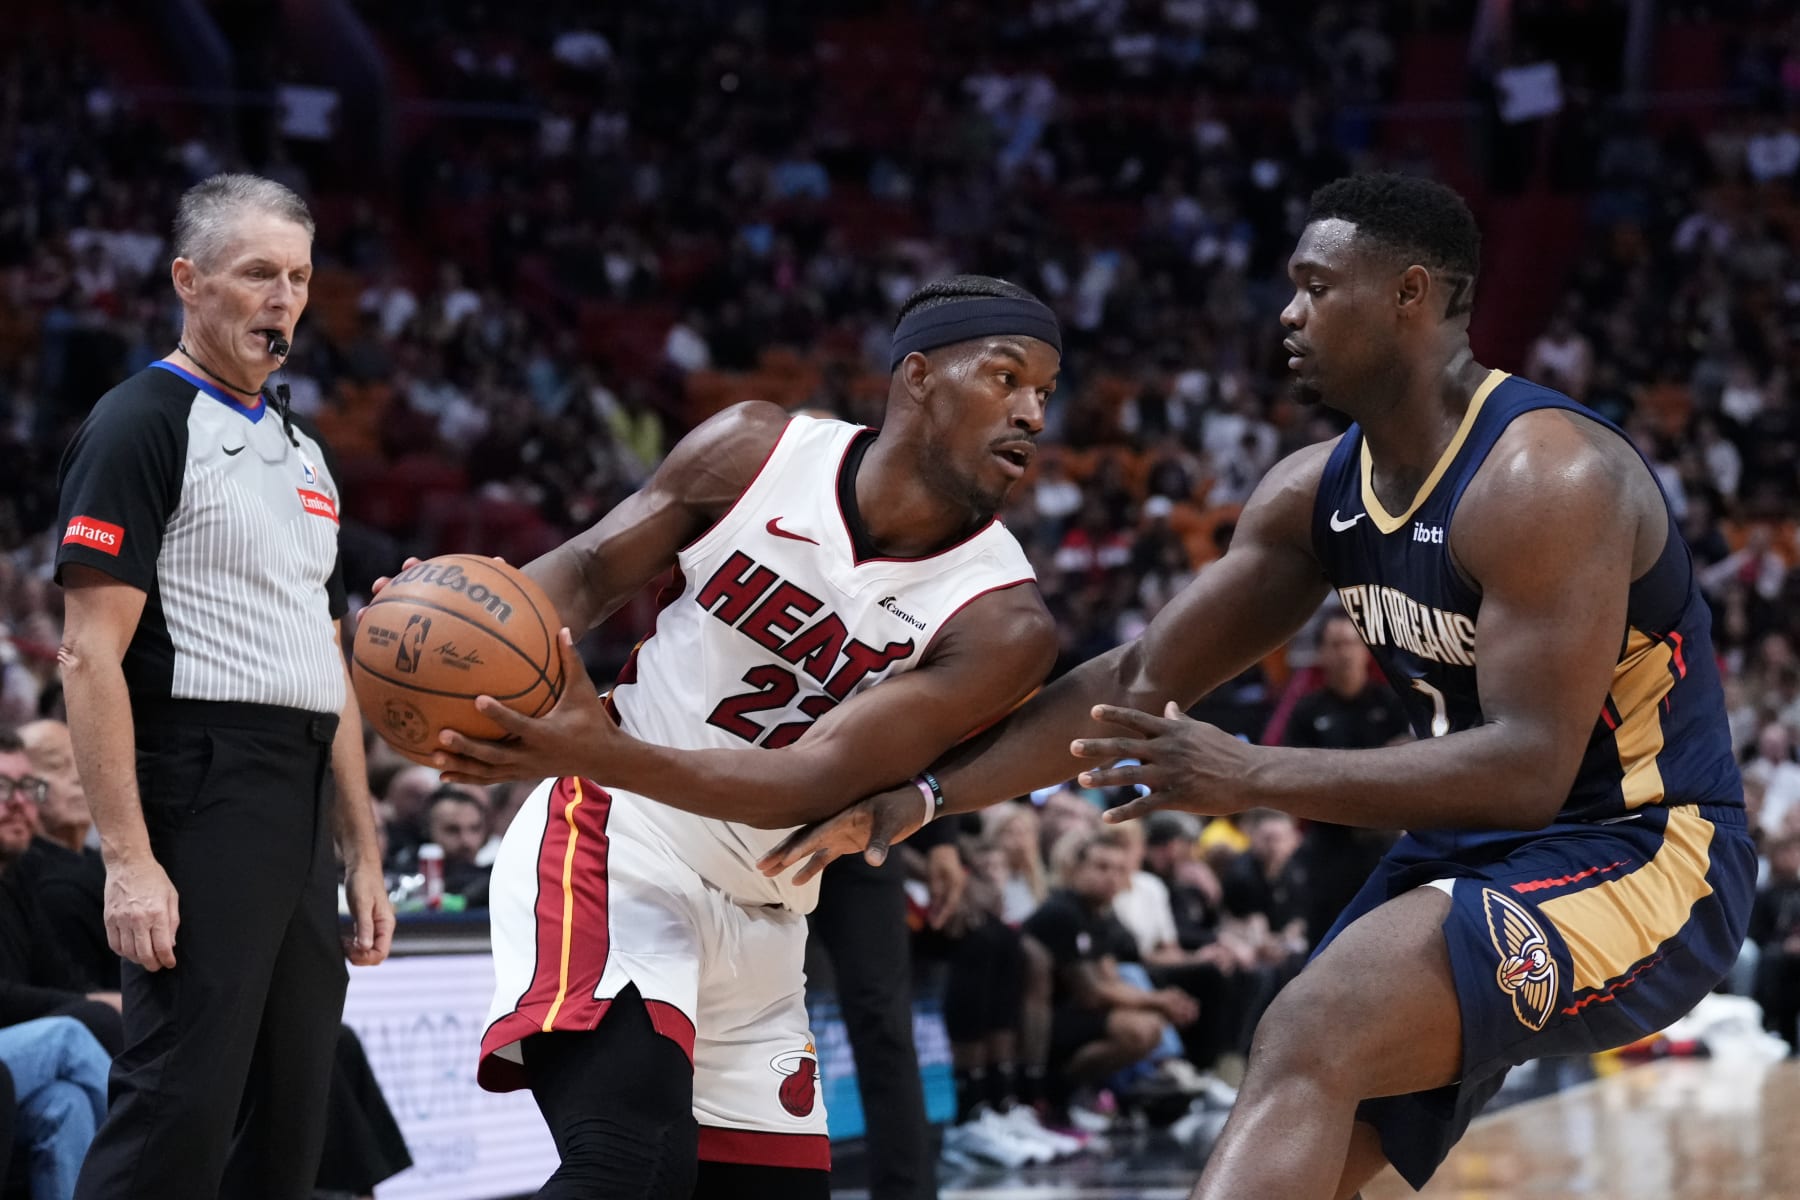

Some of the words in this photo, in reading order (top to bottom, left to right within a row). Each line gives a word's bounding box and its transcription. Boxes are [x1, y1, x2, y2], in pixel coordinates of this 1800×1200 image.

[64, 521, 116, 546] mirates
[1413, 521, 1444, 544] ibott
[391, 563, 513, 624] Wilson
[695, 550, 915, 702] HEAT
[886, 602, 927, 631] Carnival
